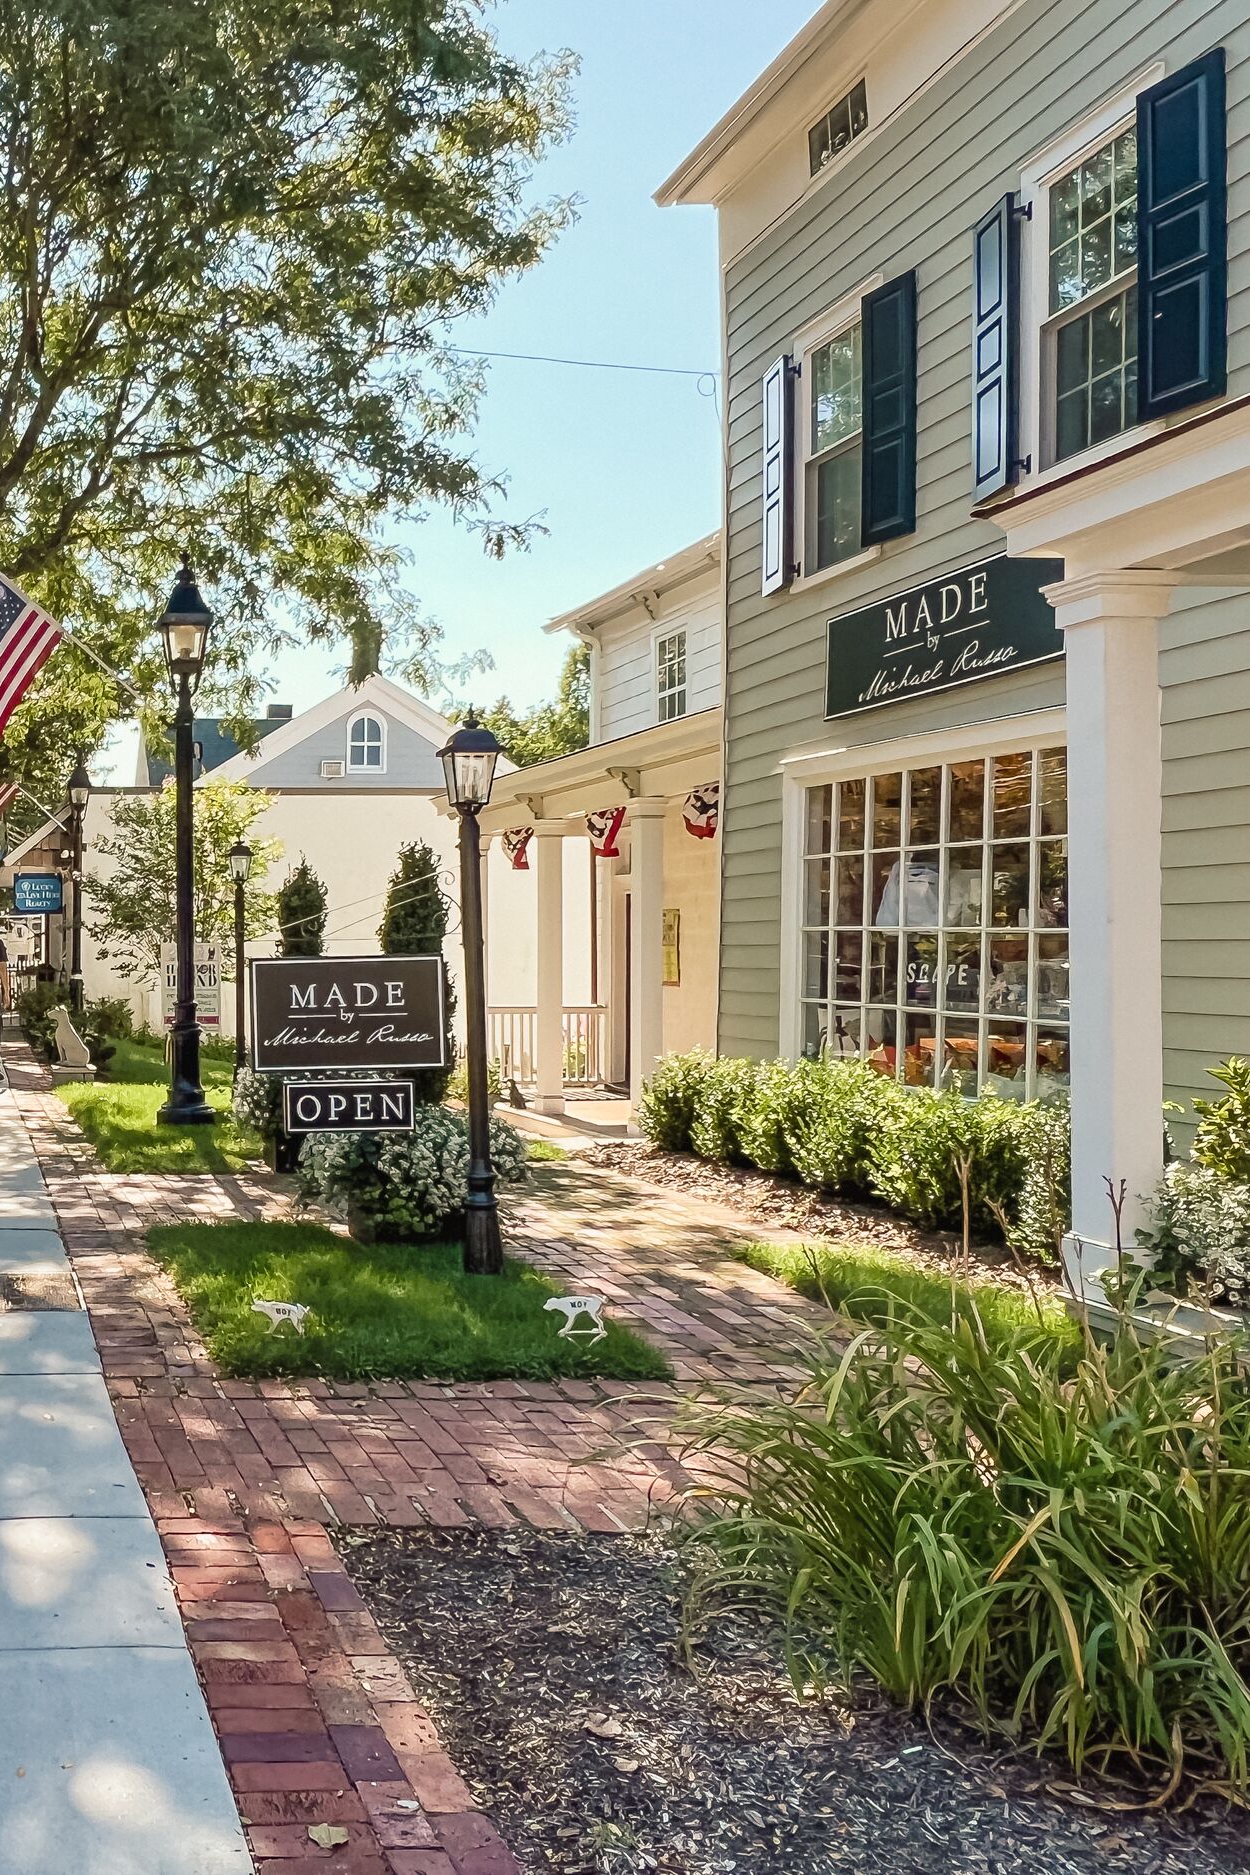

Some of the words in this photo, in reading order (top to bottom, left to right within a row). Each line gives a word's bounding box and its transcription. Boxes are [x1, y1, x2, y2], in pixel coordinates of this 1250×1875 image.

[885, 572, 988, 642] MADE
[927, 631, 940, 652] by
[858, 660, 944, 702] Michael
[950, 640, 1018, 676] Russo
[290, 982, 405, 1008] MADE
[340, 1009, 354, 1024] by
[264, 1026, 360, 1046] Michael
[366, 1025, 434, 1044] Russo
[296, 1094, 405, 1121] OPEN
